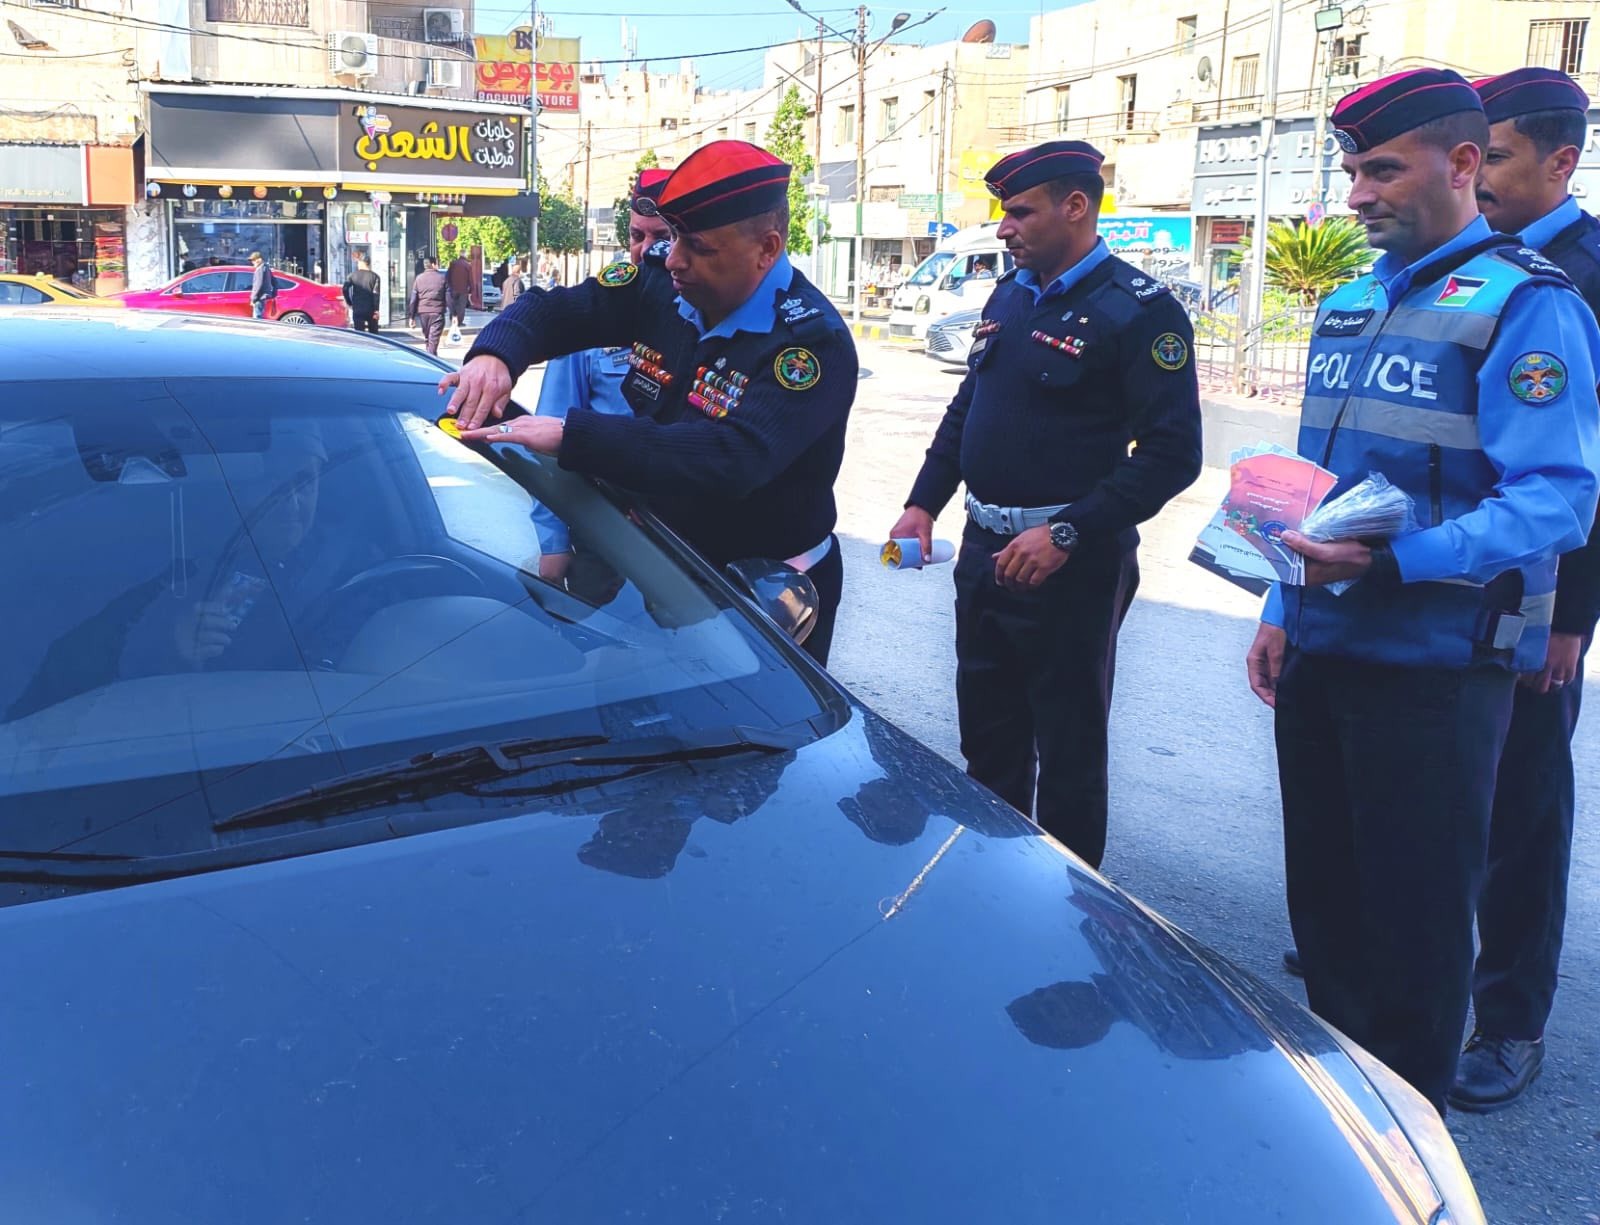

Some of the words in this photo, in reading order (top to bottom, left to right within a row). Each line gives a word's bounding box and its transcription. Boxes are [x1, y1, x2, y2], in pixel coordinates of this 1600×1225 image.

[537, 93, 573, 106] STORE
[476, 118, 515, 142] حلويات
[356, 121, 473, 171] الشعب
[475, 146, 514, 169] مرطبات
[507, 139, 515, 154] و
[1308, 353, 1438, 400] POLICE
